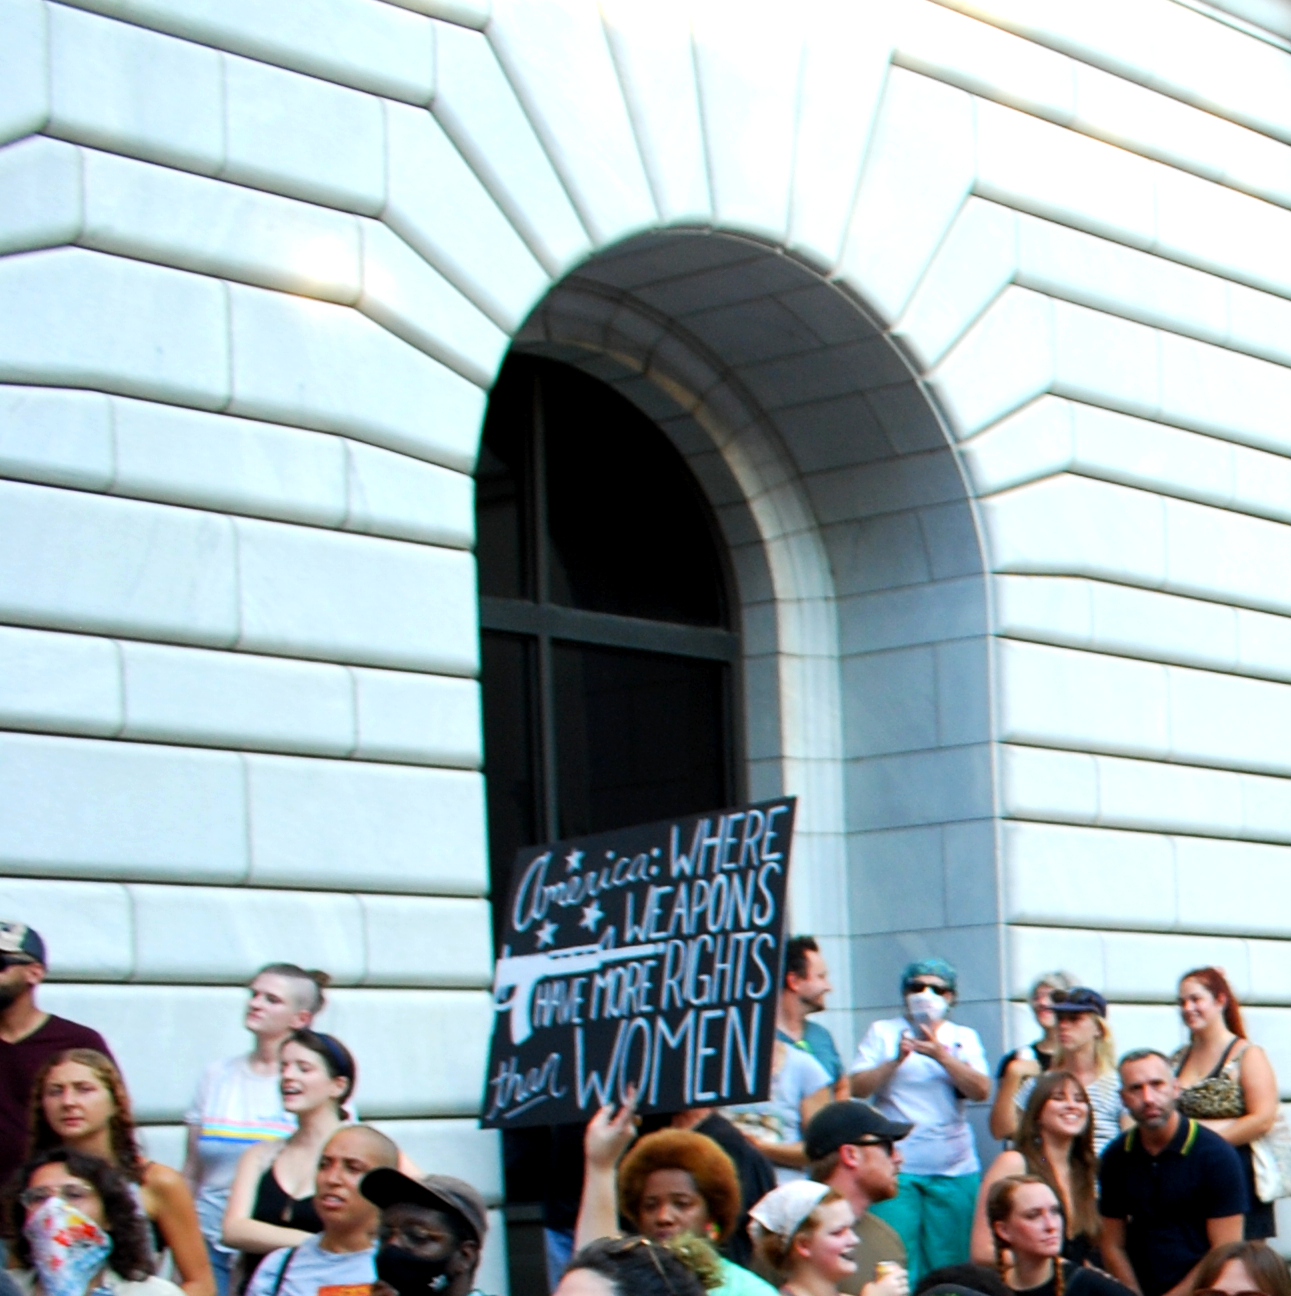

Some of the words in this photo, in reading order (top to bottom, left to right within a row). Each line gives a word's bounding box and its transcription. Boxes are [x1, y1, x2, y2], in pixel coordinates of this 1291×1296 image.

[512, 848, 660, 932] America:
[671, 805, 788, 877] WHERE
[625, 862, 781, 943] WEAPONS
[534, 978, 588, 1028] HAVE
[590, 960, 657, 1020] MORE
[661, 932, 777, 1011] RIGHTS
[487, 1052, 567, 1118] than
[574, 1003, 762, 1109] WOMEN
